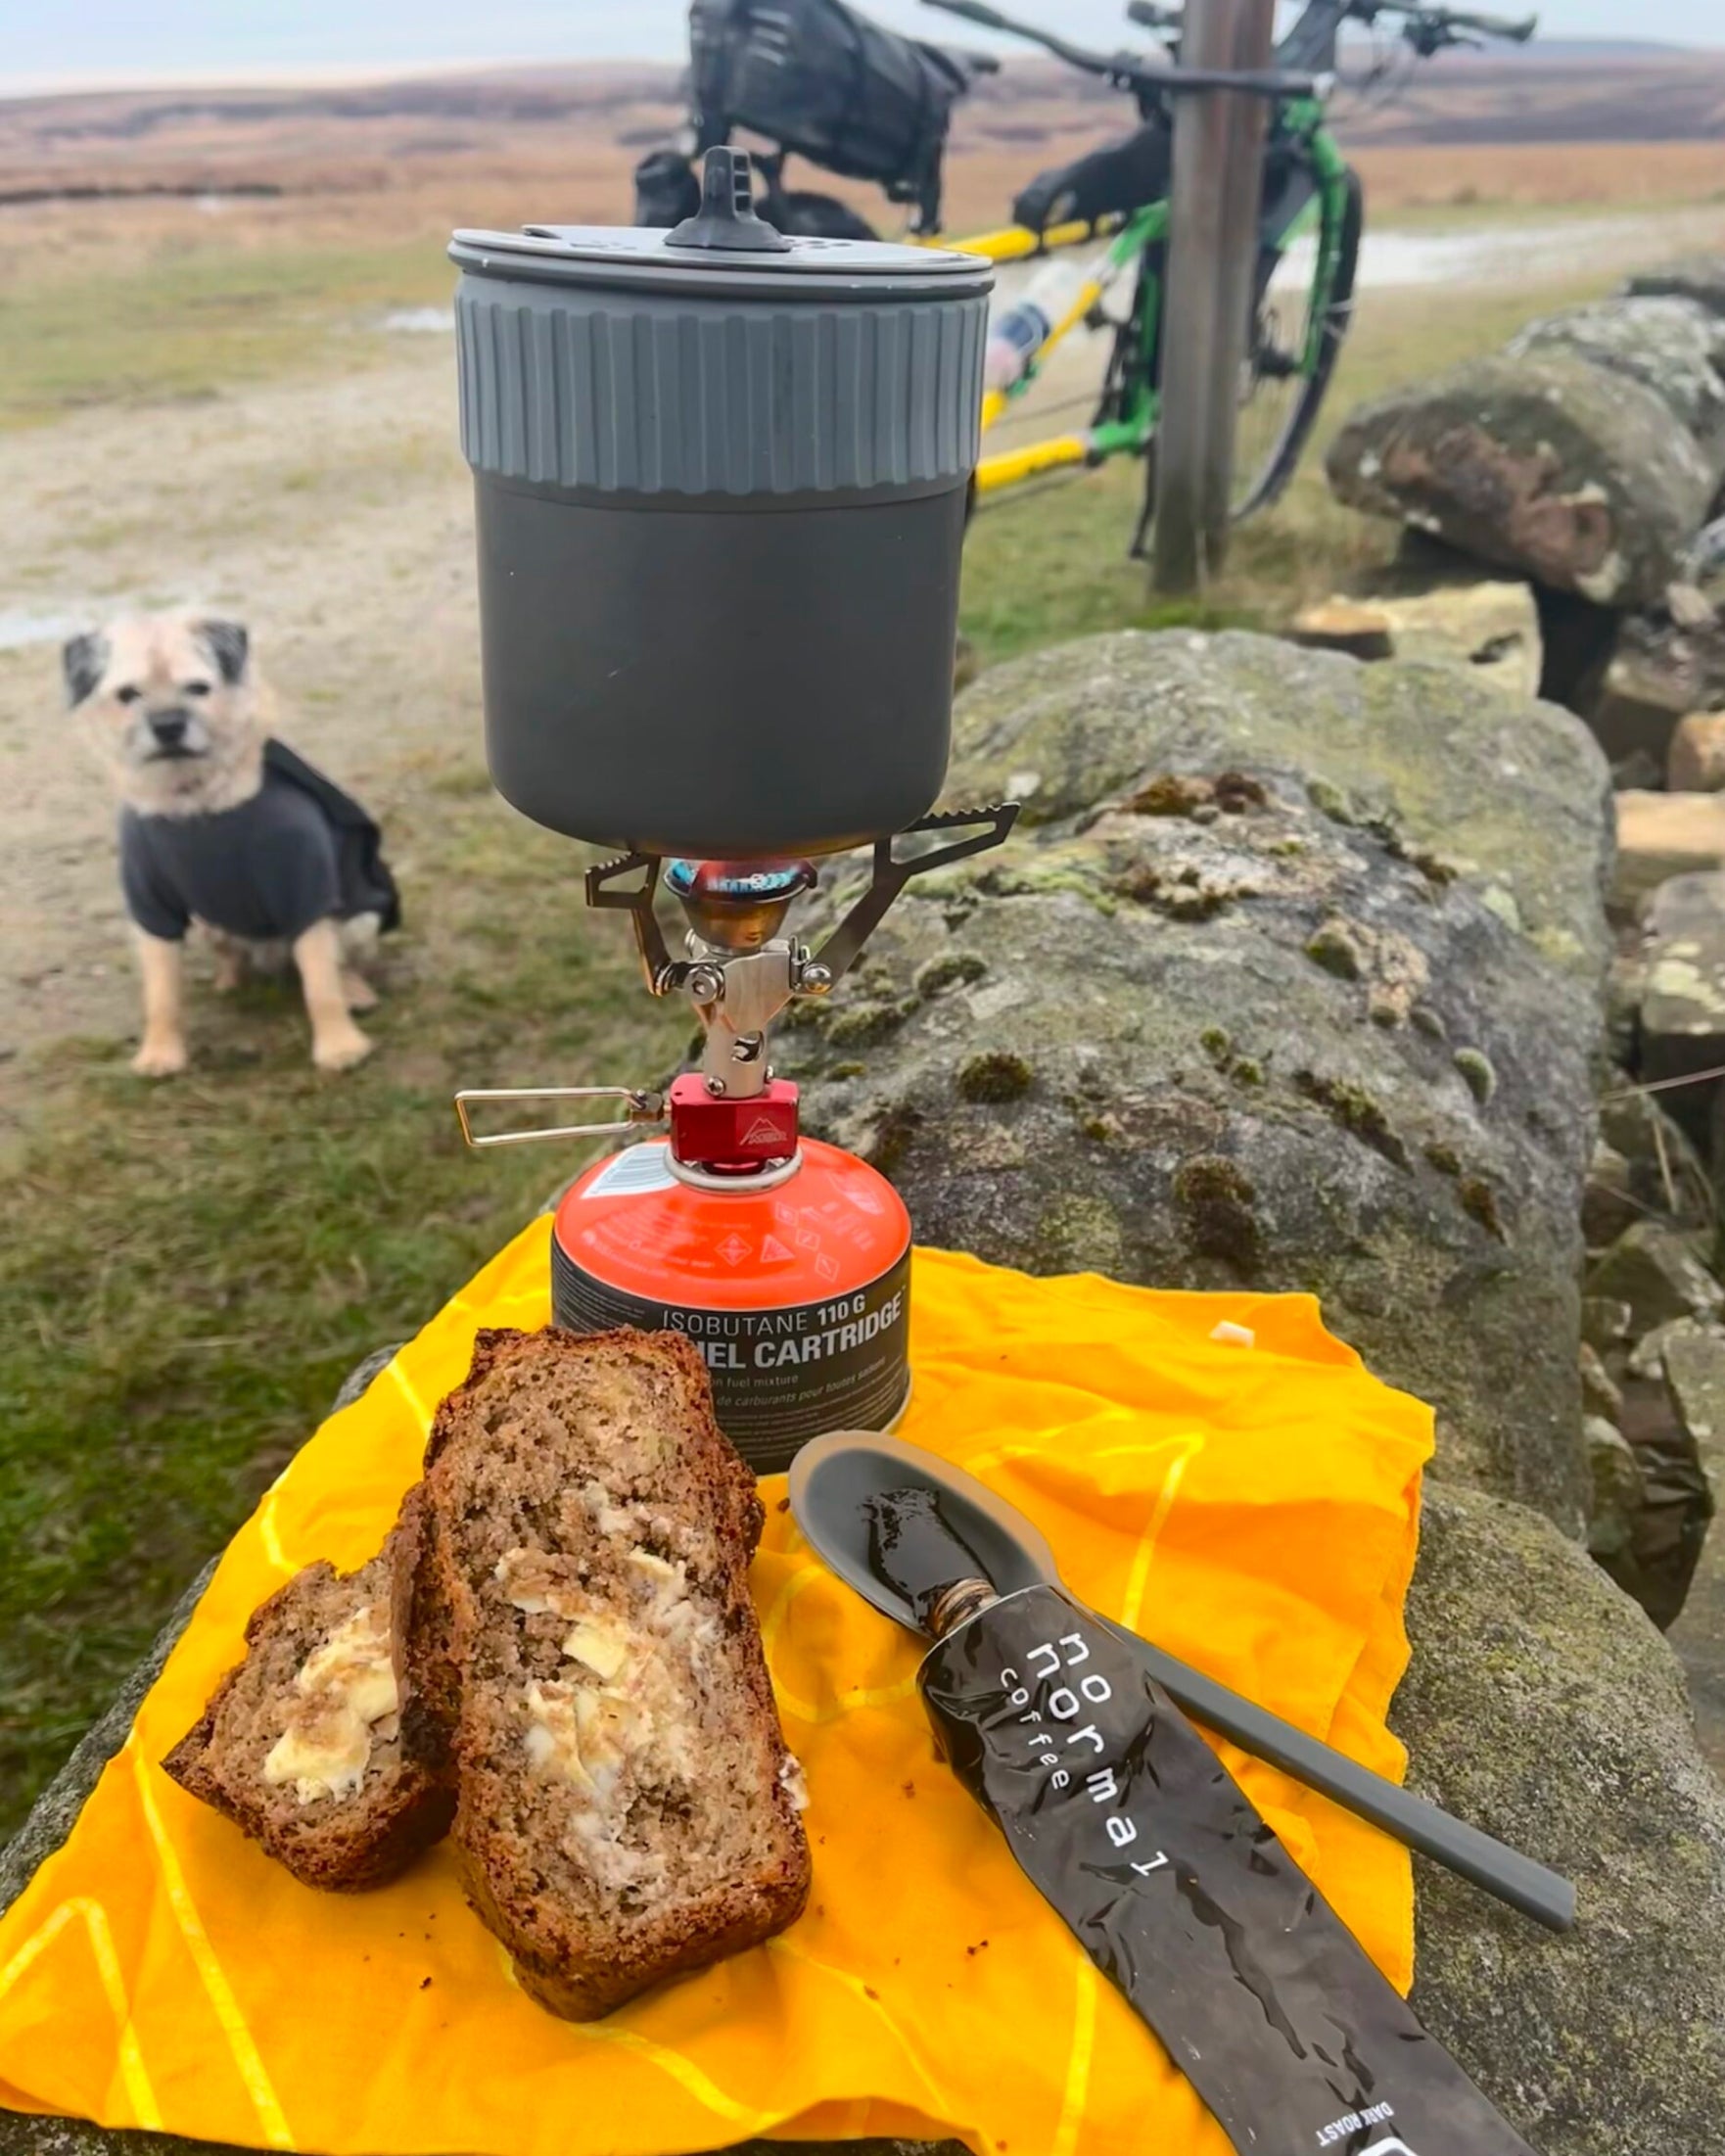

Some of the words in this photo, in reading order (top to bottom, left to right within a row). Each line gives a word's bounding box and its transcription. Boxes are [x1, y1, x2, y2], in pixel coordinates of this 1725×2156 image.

[664, 1310, 808, 1336] ISOBUTANE
[817, 1301, 849, 1326] 110
[853, 1294, 865, 1314] G
[755, 1290, 902, 1368] CARTRIDGE
[726, 1376, 750, 1387] fuel
[753, 1375, 799, 1387] mixture
[734, 1392, 797, 1407] carburants
[1059, 1632, 1112, 1704] no
[1001, 1667, 1070, 1790] coffee
[1027, 1643, 1169, 1876] normal
[1316, 2111, 1363, 2146] ROAST
[1359, 2101, 1394, 2127] DARK
